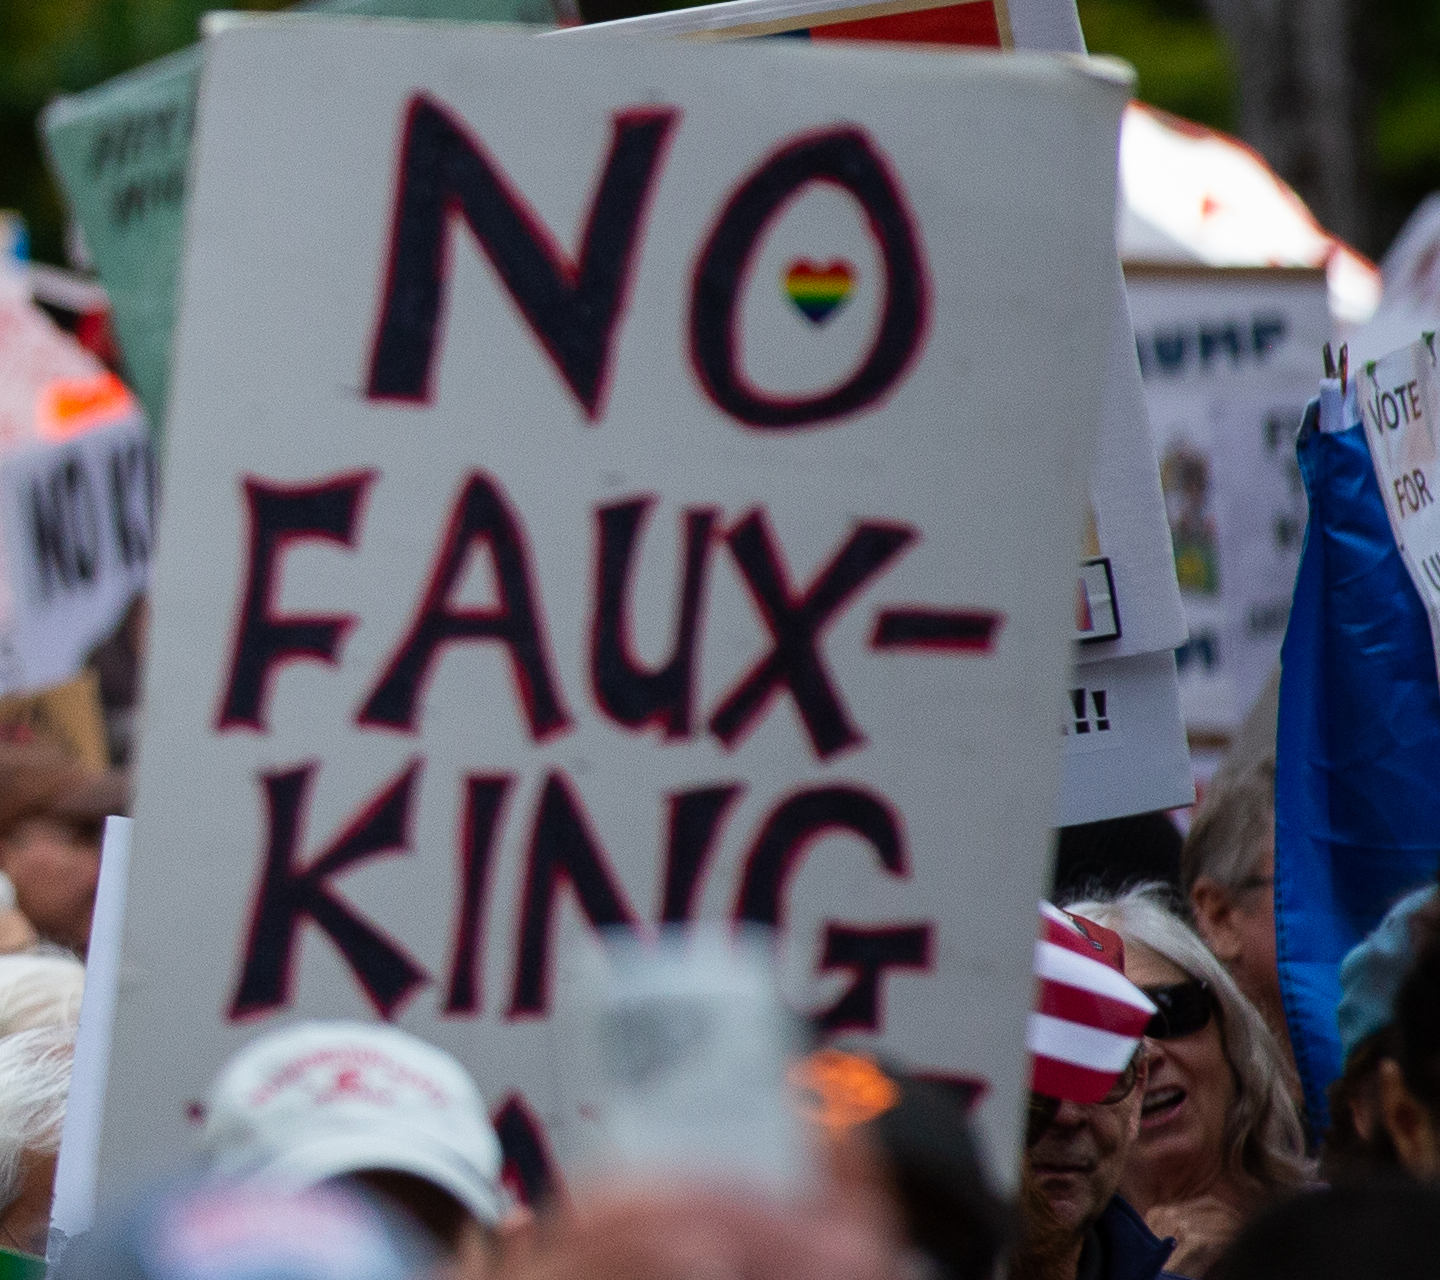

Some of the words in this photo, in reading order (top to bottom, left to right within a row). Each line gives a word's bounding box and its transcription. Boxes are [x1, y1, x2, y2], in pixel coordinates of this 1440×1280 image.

[365, 90, 934, 433] NO
[1368, 379, 1423, 436] VOTE
[1393, 468, 1434, 518] FOR
[212, 466, 1008, 763] FAUX-
[224, 754, 936, 1034] KING
